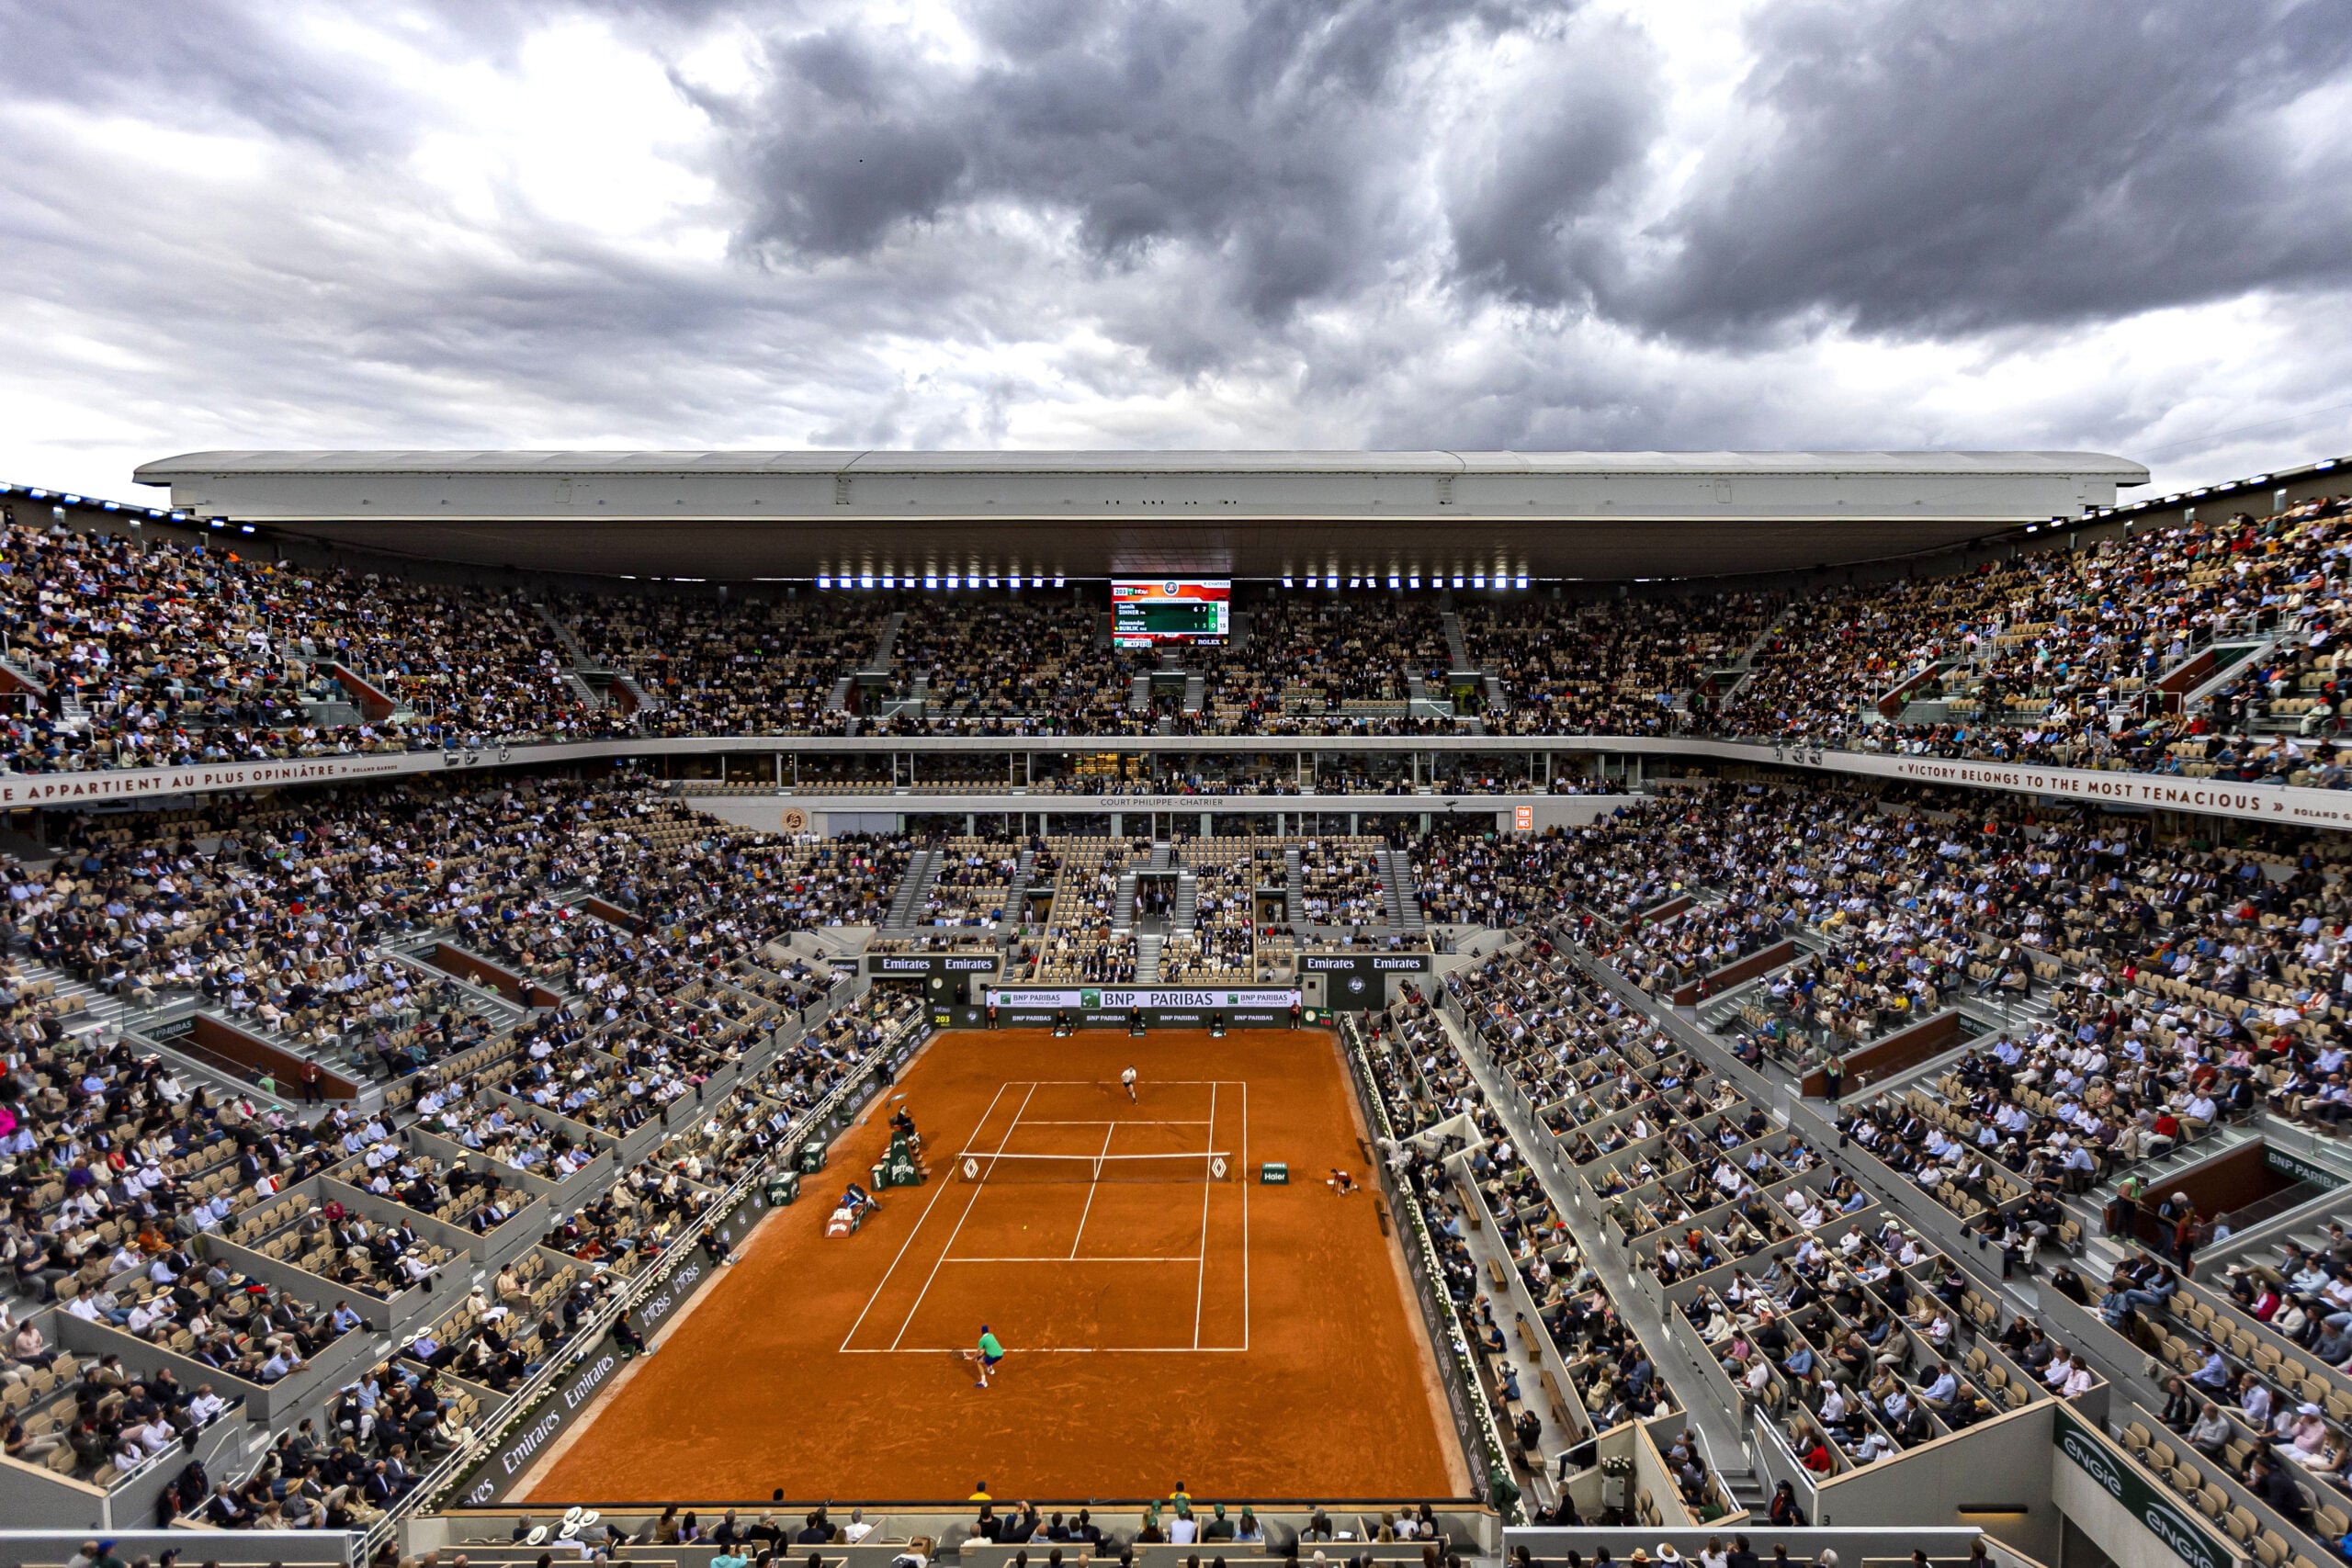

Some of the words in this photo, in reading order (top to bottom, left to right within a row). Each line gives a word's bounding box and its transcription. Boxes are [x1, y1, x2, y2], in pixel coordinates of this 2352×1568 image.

[28, 777, 162, 799] APPARTIENT
[172, 774, 194, 788] AU
[205, 772, 243, 784] PLUS
[253, 764, 334, 781] OPINIÂTRE
[1907, 763, 1956, 779] VICTORY
[1962, 769, 2019, 785] BELONGS
[2027, 775, 2043, 788] TO
[2051, 777, 2079, 792] THE
[2087, 781, 2132, 797] MOST
[2143, 785, 2260, 811] TENACIOUS
[2294, 808, 2338, 819] ROLAND
[883, 958, 931, 970] Emirates
[944, 958, 992, 970] Emirates
[1307, 957, 1355, 969] Emirates
[1374, 957, 1420, 969] Emirates
[1104, 993, 1135, 1006] BNP
[1150, 993, 1213, 1006] PARIBAS
[156, 1020, 192, 1037] PARIBAS
[2268, 1152, 2294, 1169] BNP
[564, 1352, 615, 1409] Emirates
[502, 1409, 560, 1474] Emirates
[1823, 1514, 1831, 1527] 3
